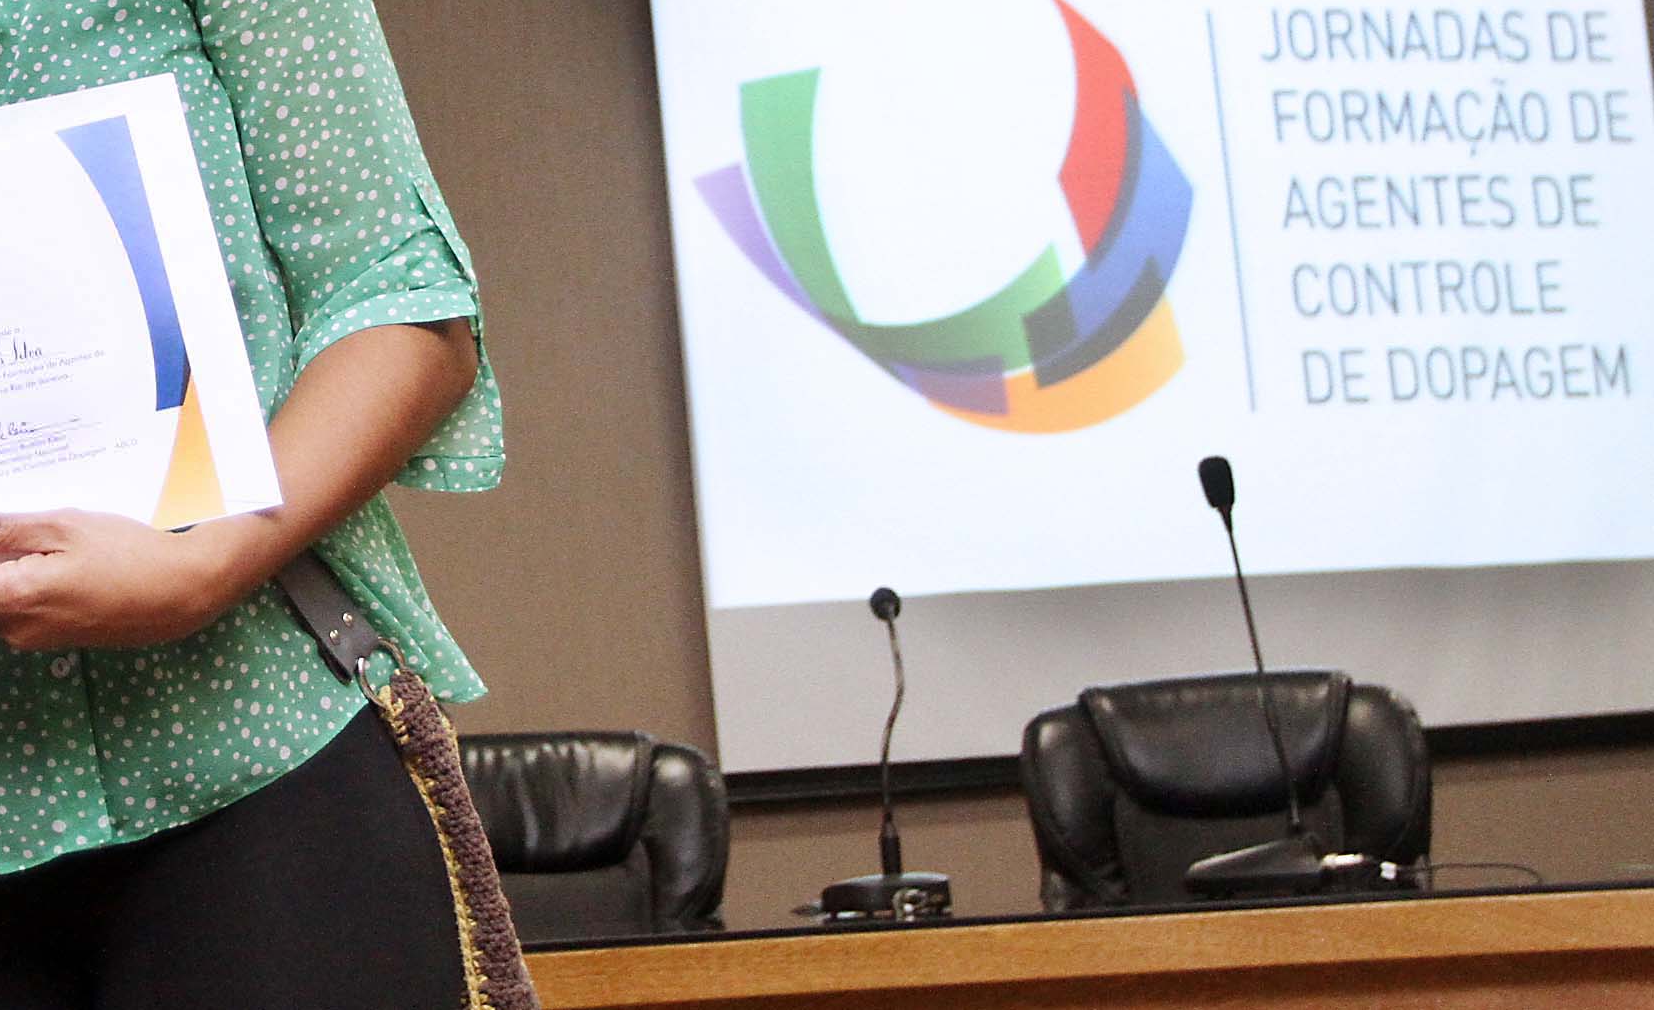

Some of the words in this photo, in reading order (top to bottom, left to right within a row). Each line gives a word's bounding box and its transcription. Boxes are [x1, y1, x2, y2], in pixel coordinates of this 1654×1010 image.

[1260, 7, 1532, 63] JORNADAS
[1547, 9, 1614, 63] DE
[1272, 78, 1549, 156] FORMAÇÃO
[1568, 90, 1635, 144] DE
[1282, 176, 1517, 229] AGENTES
[1532, 175, 1601, 228] DE
[1291, 261, 1566, 316] CONTROLE
[1302, 349, 1367, 405] DE
[1387, 344, 1632, 403] DOPAGEM
